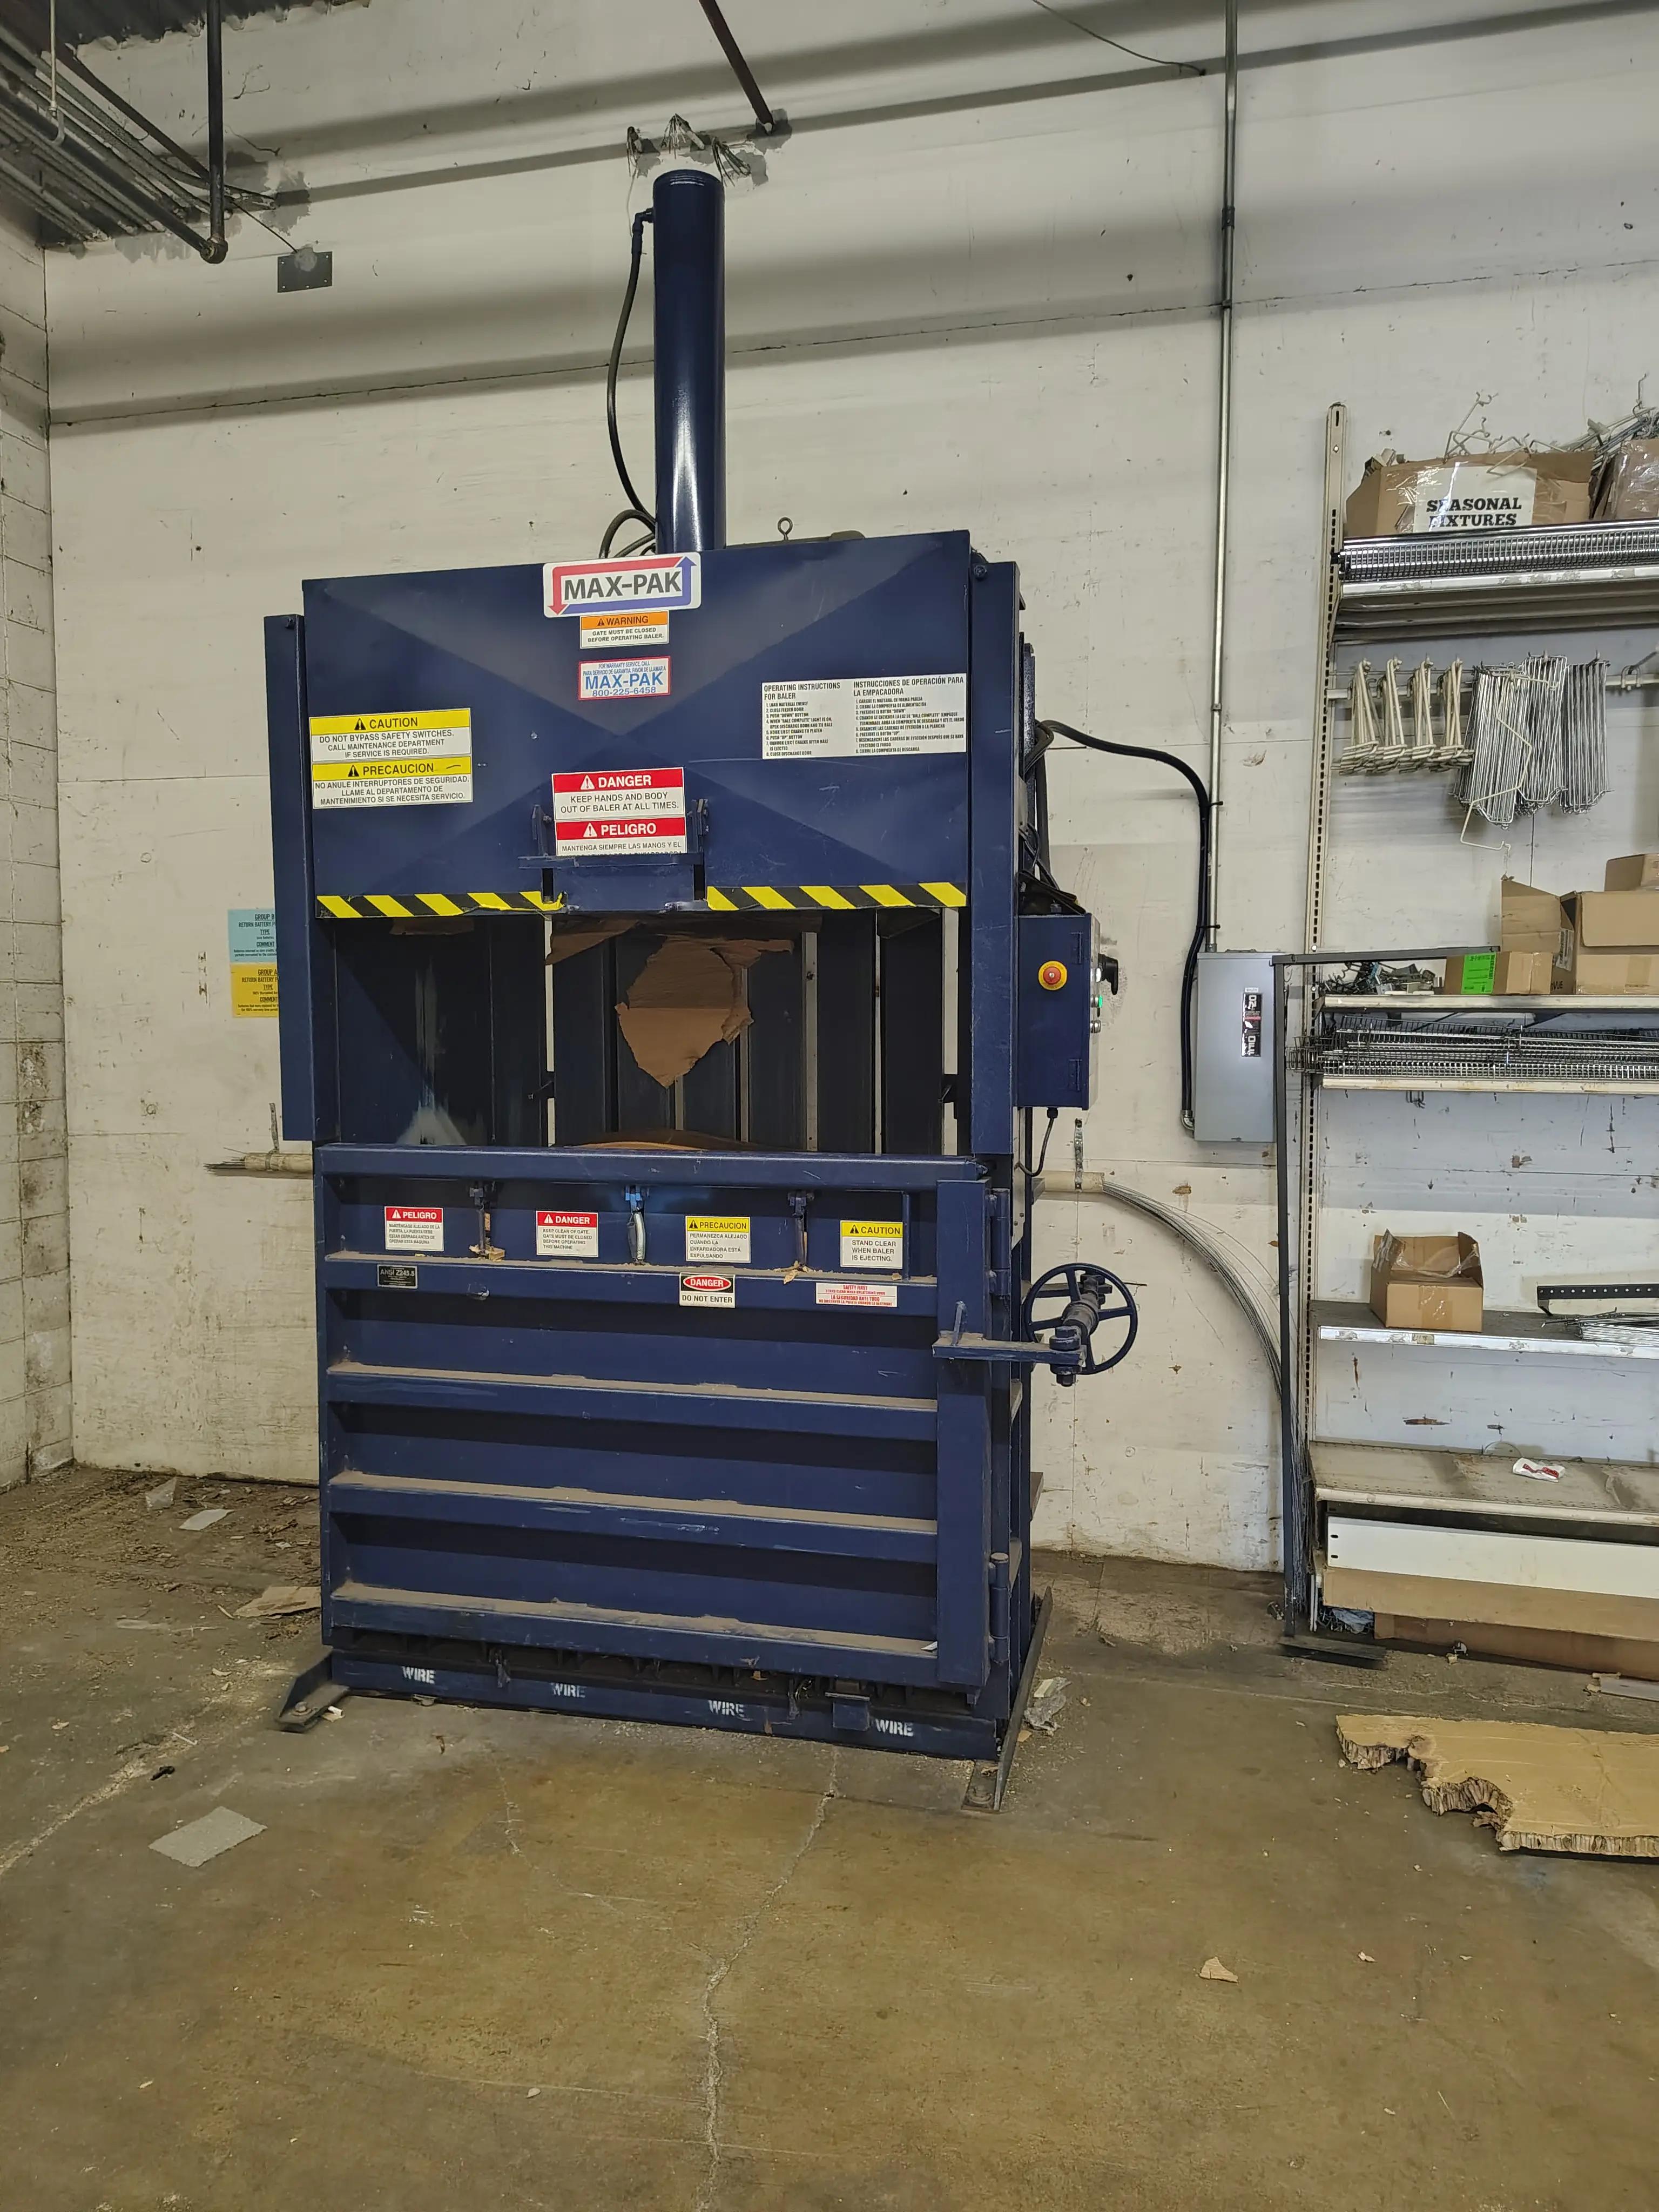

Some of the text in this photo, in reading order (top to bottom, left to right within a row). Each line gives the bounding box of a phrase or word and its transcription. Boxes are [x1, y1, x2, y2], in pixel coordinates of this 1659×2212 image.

[564, 571, 682, 600] MAX-PAK
[606, 616, 648, 625] WARNING
[585, 672, 663, 690] MAX-PAK
[764, 682, 840, 692] OPERATING INSTRUCTIONS
[853, 679, 900, 688] INSTRUCCIONES
[912, 676, 946, 685] OPERACIÓN
[592, 687, 656, 697] 800-225-6458
[862, 687, 903, 696] EMPACADORA
[369, 717, 417, 729] CAUTION
[319, 736, 330, 744] DO
[332, 734, 348, 743] NOT
[349, 733, 380, 742] BYPASS
[381, 731, 410, 740] SAFETY
[347, 741, 397, 750] MAINTENANCE
[398, 739, 444, 748] DEPARTMENT
[353, 750, 382, 758] SERVICE
[392, 747, 429, 756] REQUIRED.
[363, 764, 434, 775] PRECAUCION
[327, 781, 351, 789] ANULE
[353, 778, 412, 787] INTERRUPTORES
[598, 775, 651, 788] DANGER
[376, 786, 431, 795] DEPARTAMENTO
[320, 795, 376, 805] MANTENIMIENTO
[396, 793, 429, 801] NECESITA
[431, 792, 465, 800] SERVICIO.
[570, 795, 592, 804] KEEP
[594, 793, 623, 802] HANDS
[645, 791, 668, 799] BODY
[561, 805, 577, 813] OUT
[579, 805, 590, 813] OF
[593, 804, 620, 812] BALER
[652, 801, 678, 810] TIMES.
[601, 823, 656, 835] PELIGRO
[861, 1226, 900, 1235] CAUTION
[691, 1278, 724, 1287] DANGER
[402, 1666, 435, 1684] WIRE
[549, 1683, 586, 1698] WIRE
[708, 1700, 744, 1717] WIRE
[875, 1718, 913, 1737] WIRE
